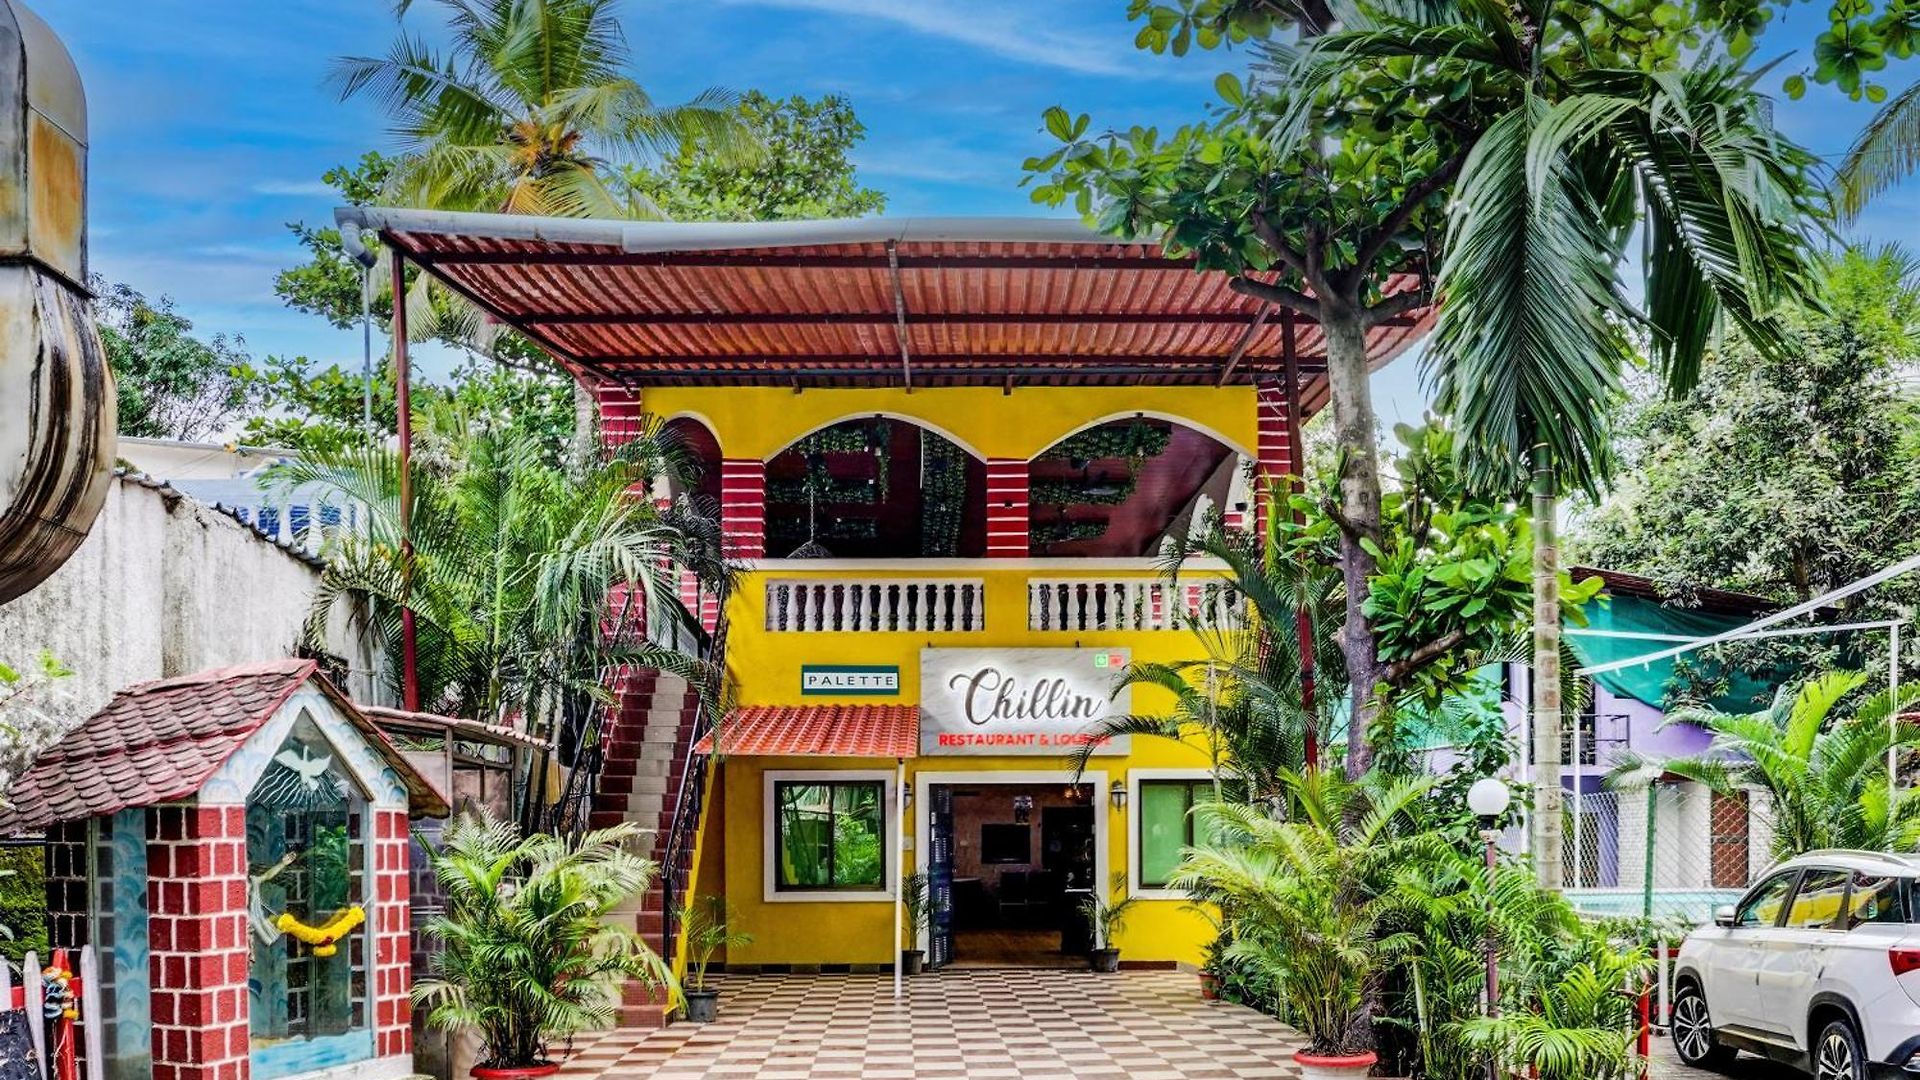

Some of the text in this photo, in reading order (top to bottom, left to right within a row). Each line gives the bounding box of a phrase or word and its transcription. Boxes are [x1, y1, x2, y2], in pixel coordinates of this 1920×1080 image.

[808, 675, 894, 686] PALETTE
[949, 667, 1103, 725] Chillin
[938, 733, 1112, 746] RESTAURANT & LOUE
